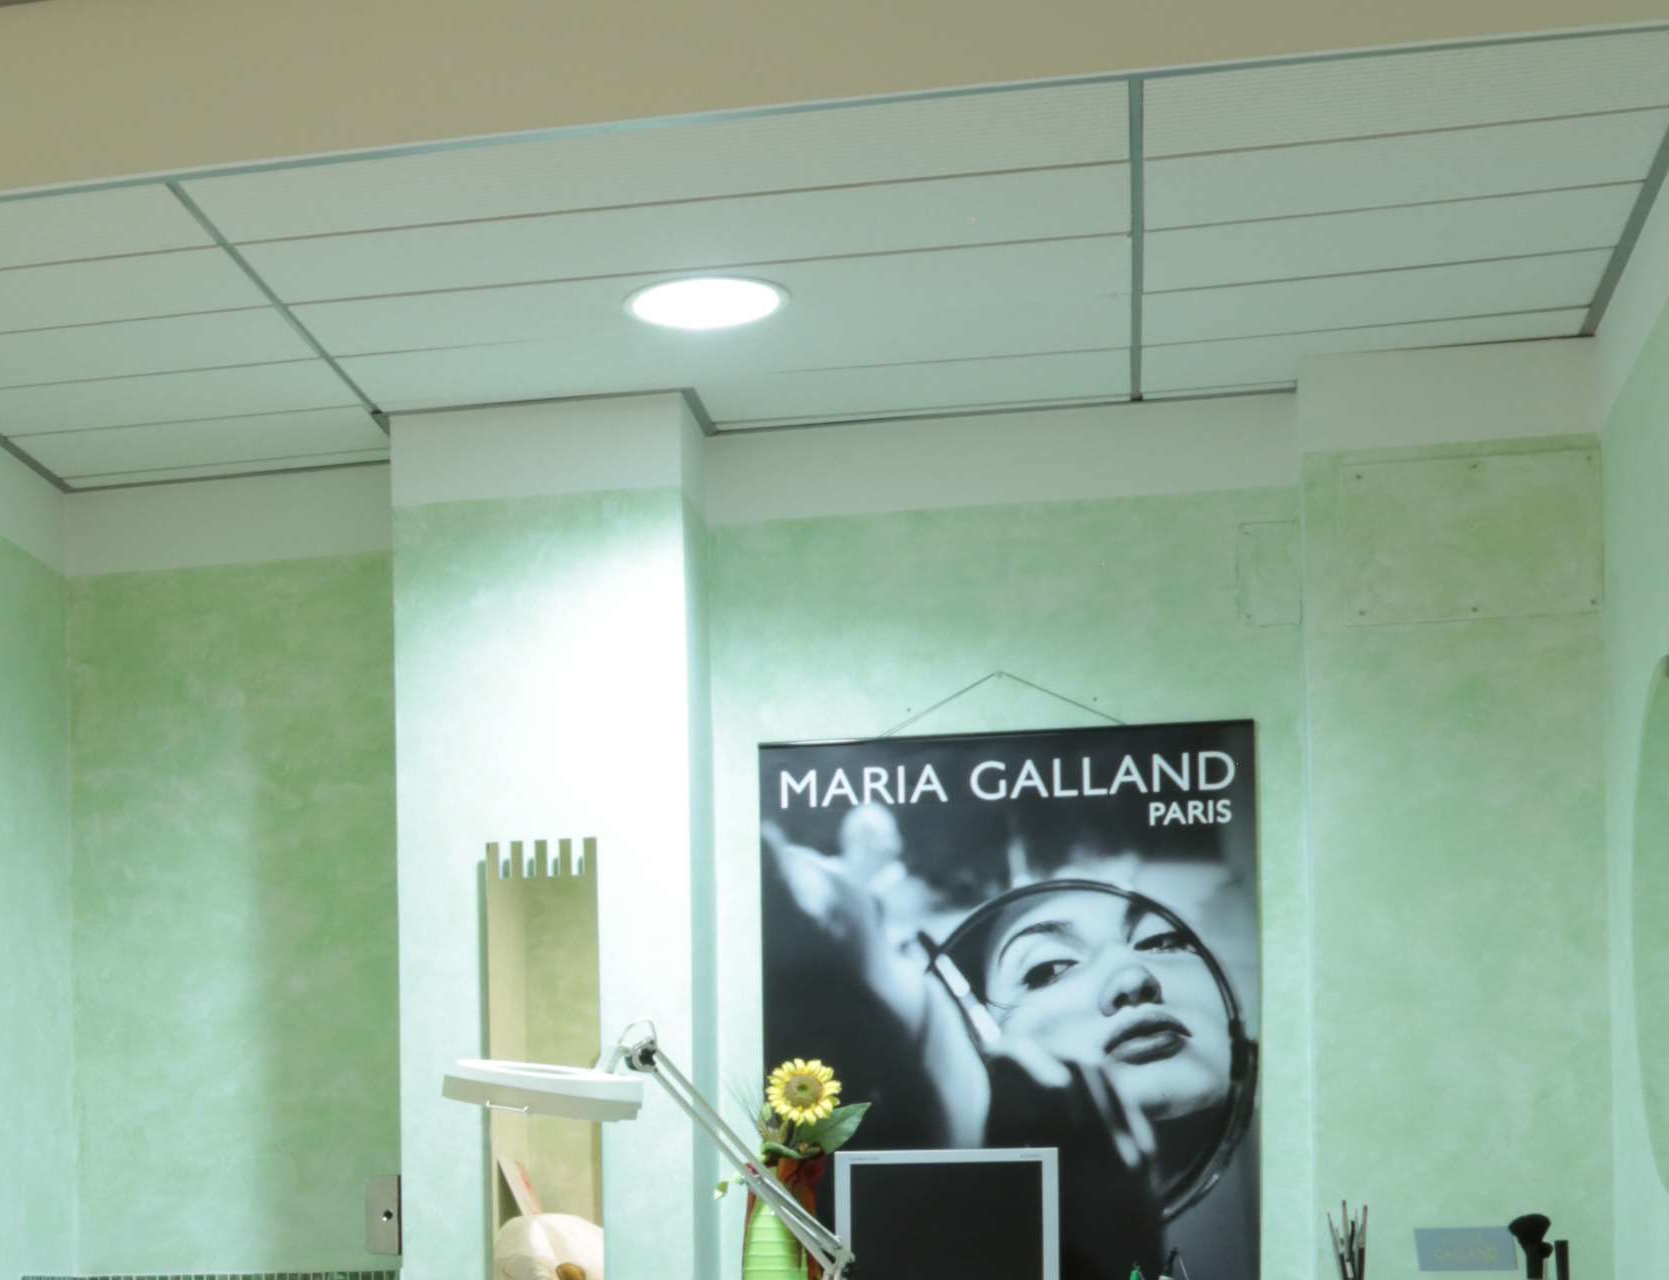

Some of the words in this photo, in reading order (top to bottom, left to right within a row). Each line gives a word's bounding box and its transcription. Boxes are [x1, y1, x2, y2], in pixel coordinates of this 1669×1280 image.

[779, 763, 949, 809] MARIA
[968, 750, 1236, 801] GALLAND
[1148, 799, 1233, 827] PARIS
